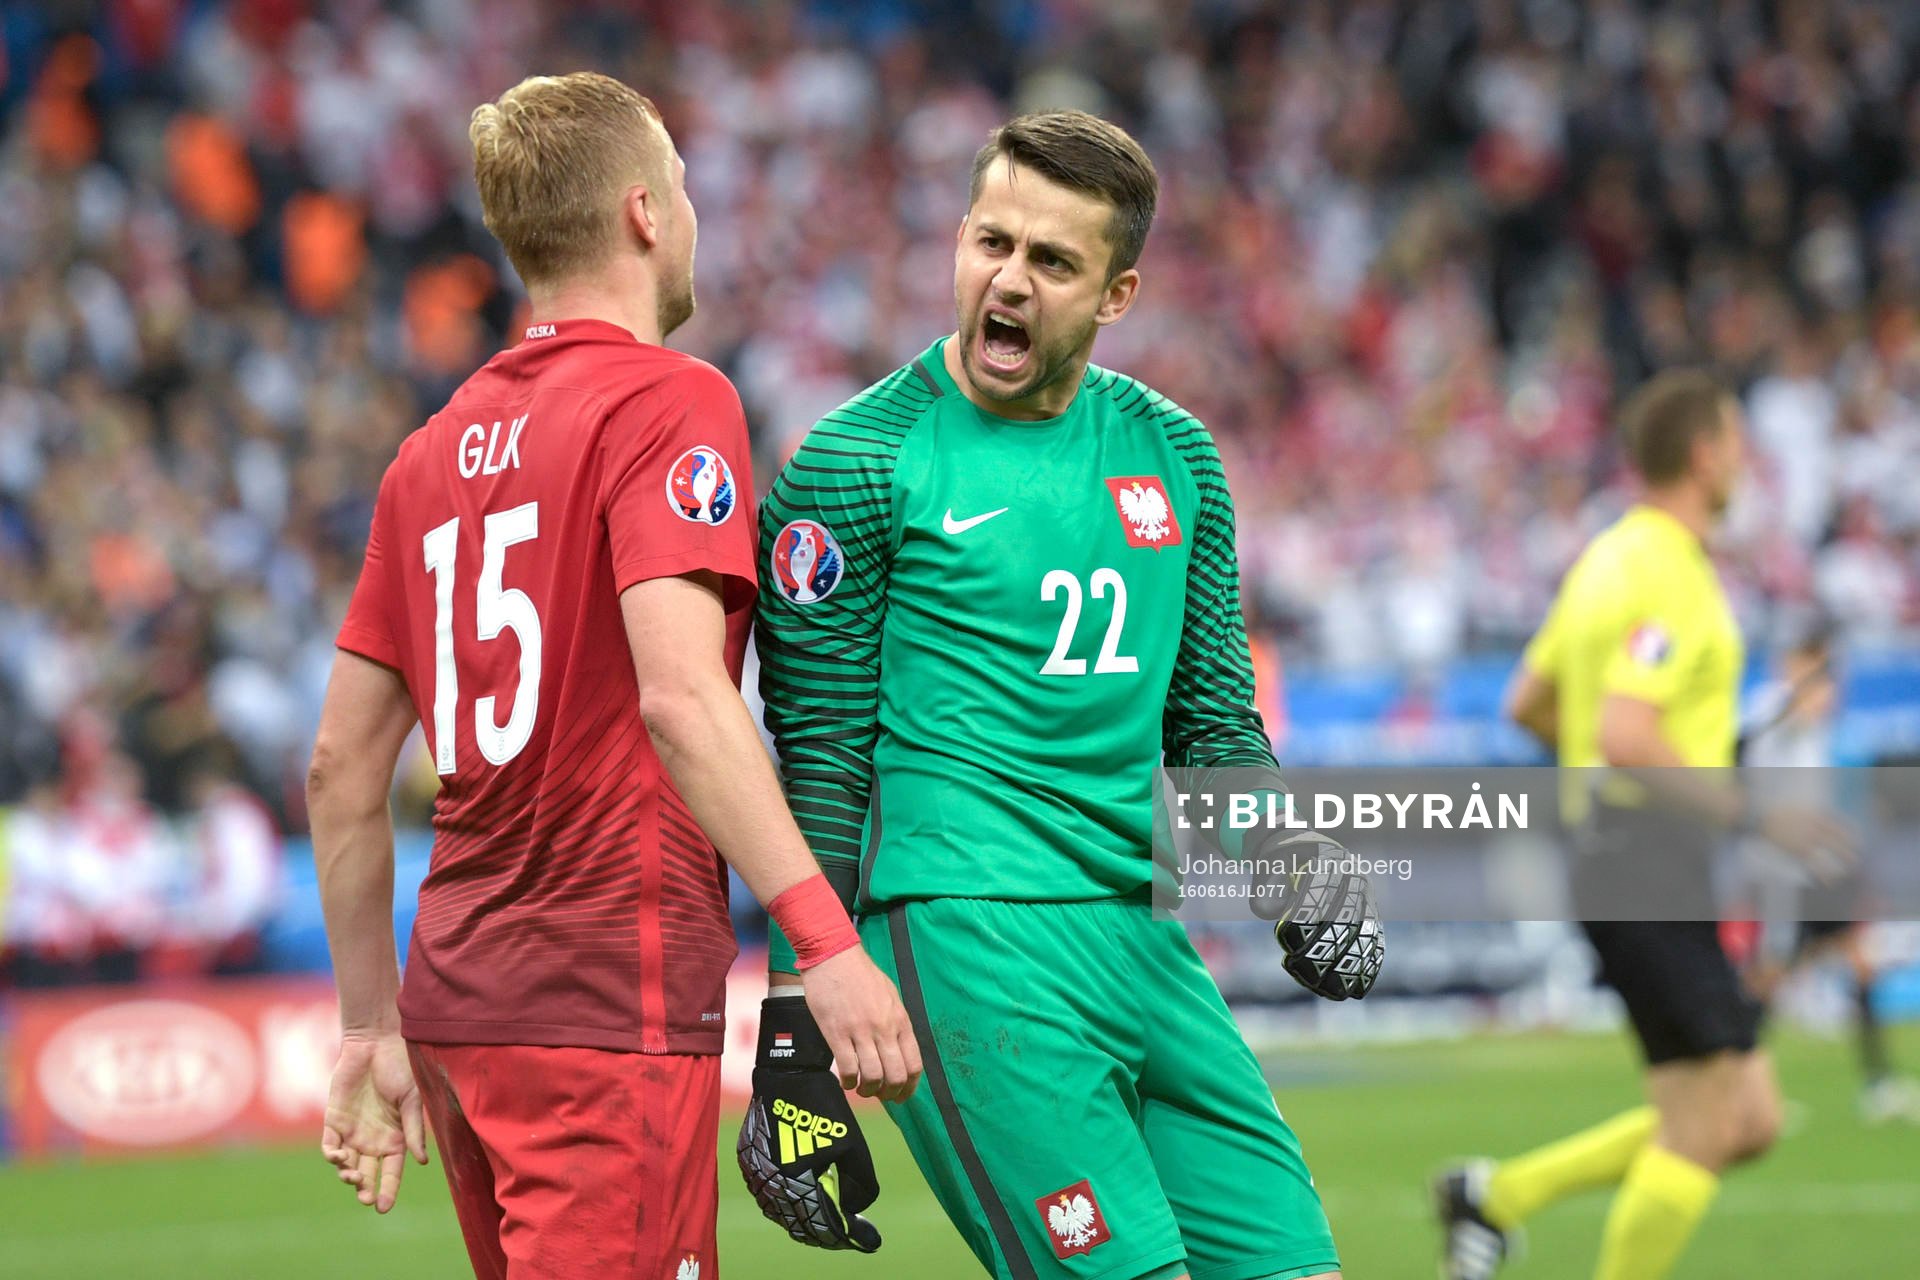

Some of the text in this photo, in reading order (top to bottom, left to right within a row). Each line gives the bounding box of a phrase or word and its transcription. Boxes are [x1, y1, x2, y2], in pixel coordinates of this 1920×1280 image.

[525, 324, 557, 340] POLSKA
[423, 501, 542, 775] 15
[1039, 567, 1139, 675] 22
[772, 1098, 848, 1138] adidas
